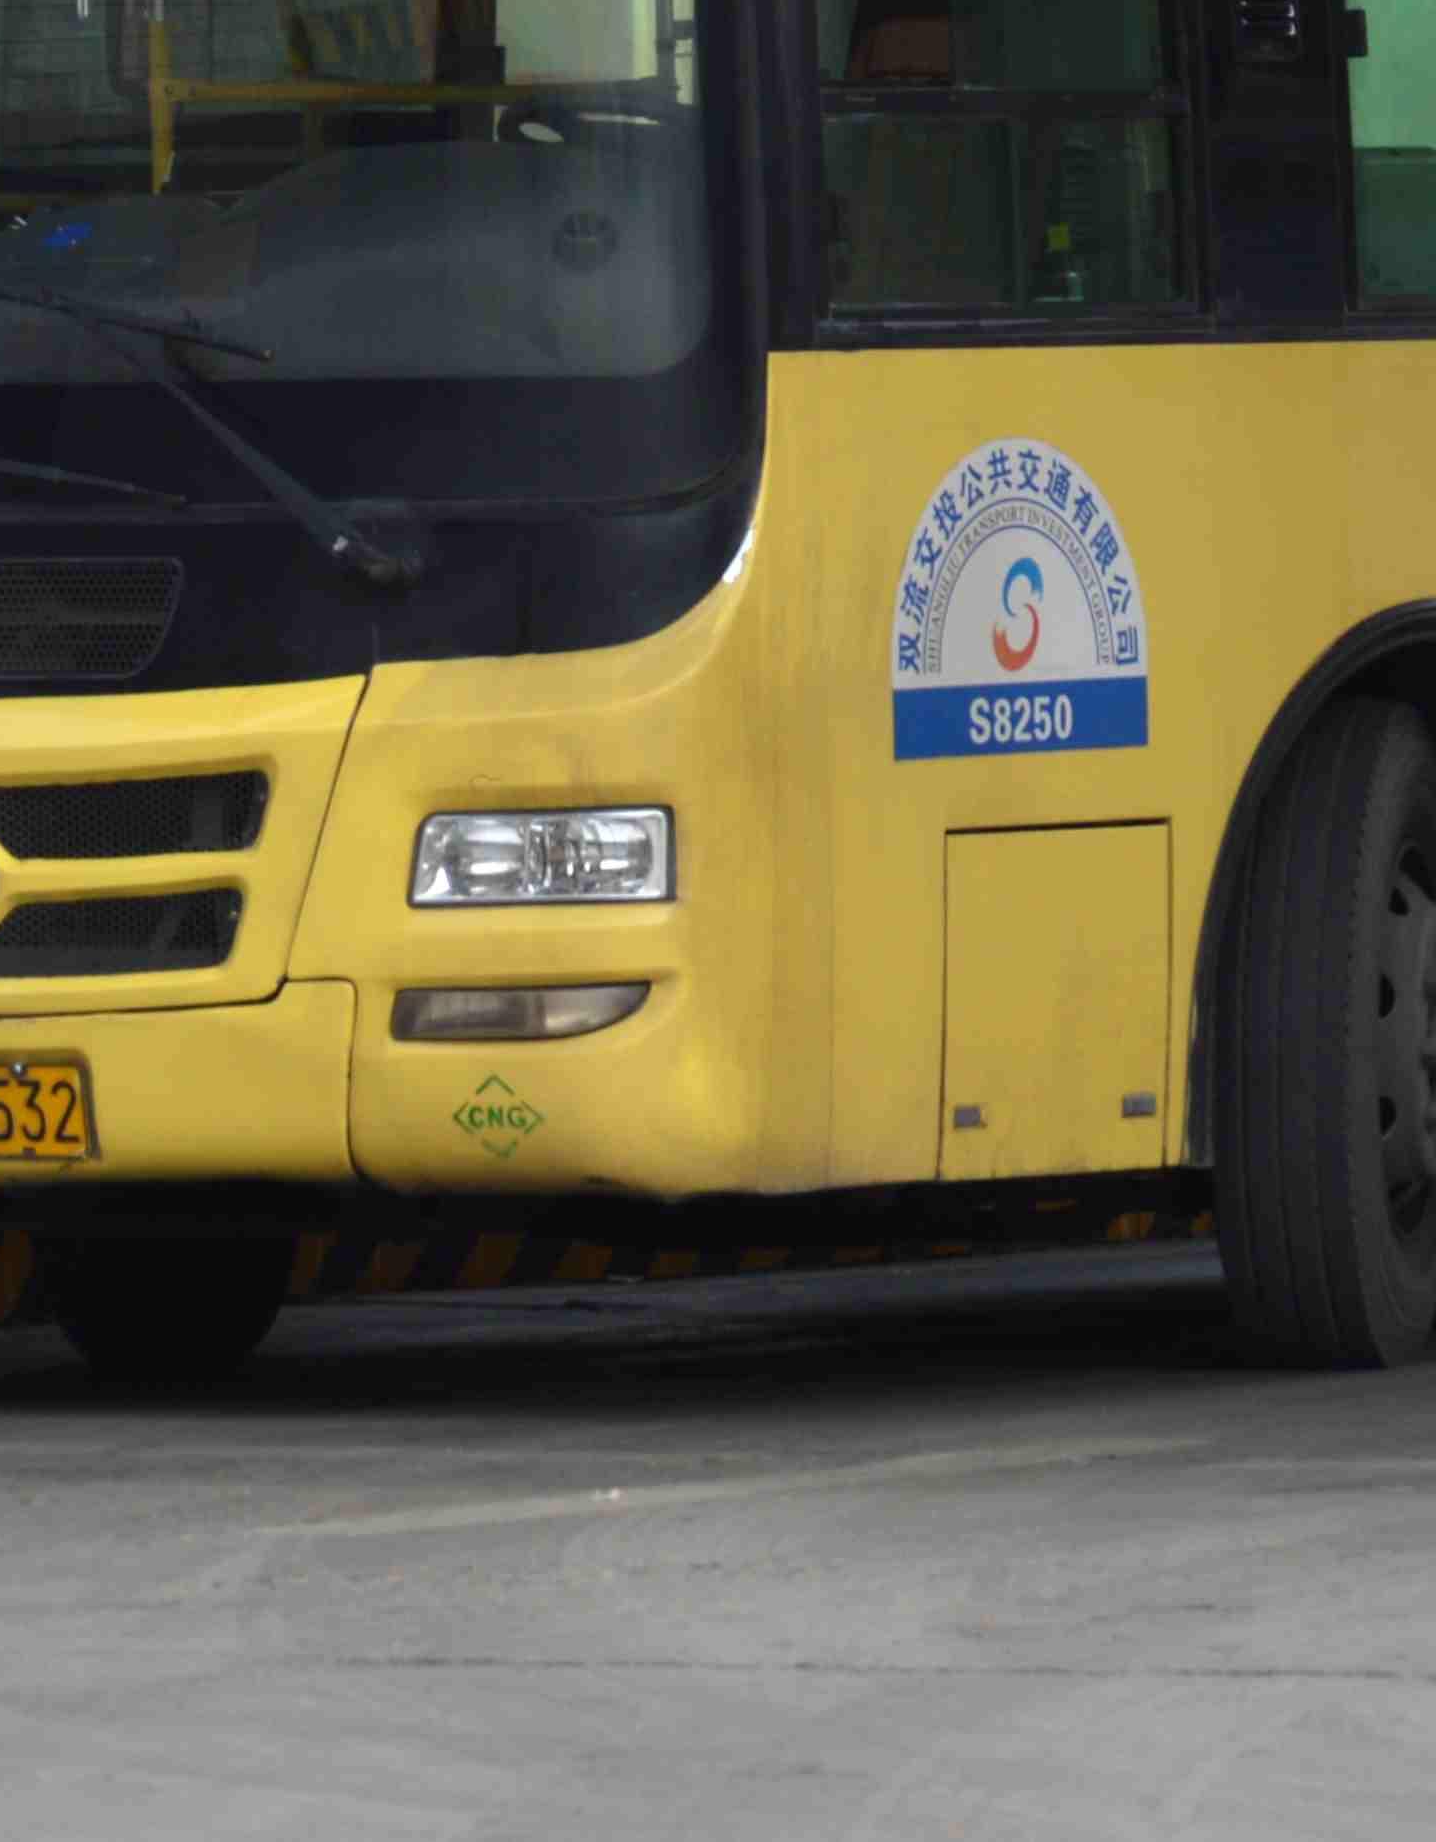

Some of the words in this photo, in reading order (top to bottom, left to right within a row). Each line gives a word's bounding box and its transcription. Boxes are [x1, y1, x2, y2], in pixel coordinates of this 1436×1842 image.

[898, 448, 1139, 674] 双流交投公共交通有限公司
[969, 694, 1074, 745] S8250
[467, 1104, 529, 1131] CNG
